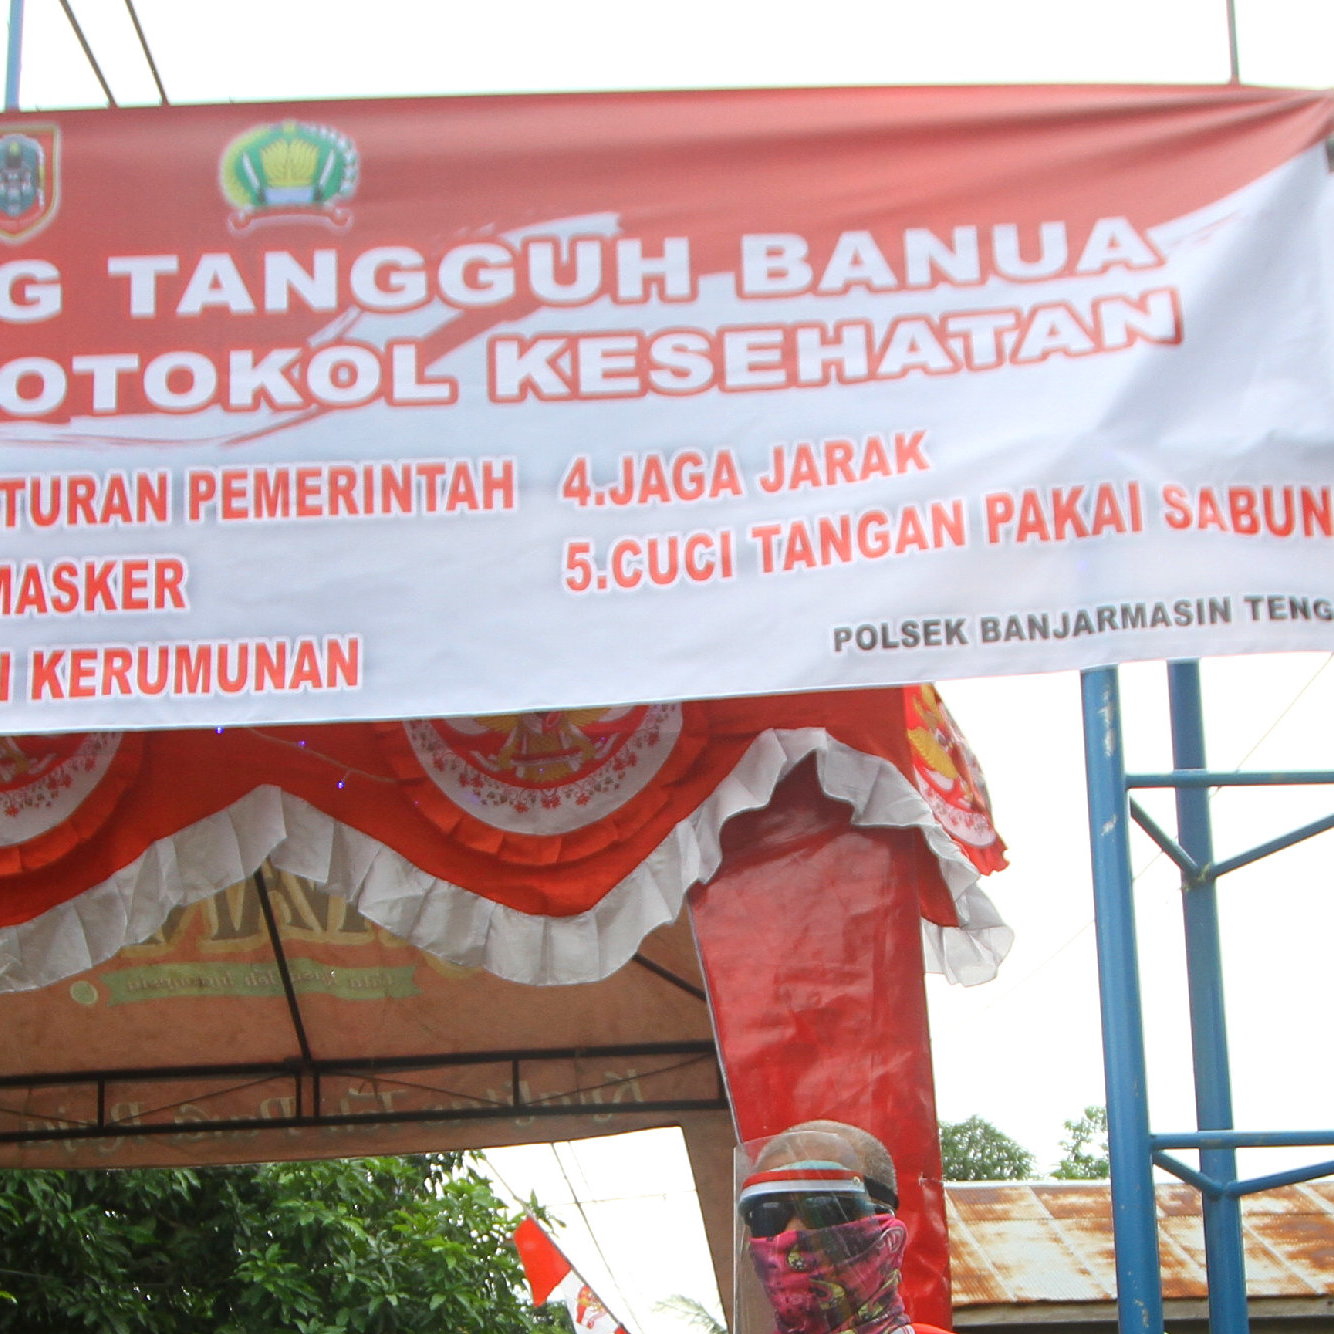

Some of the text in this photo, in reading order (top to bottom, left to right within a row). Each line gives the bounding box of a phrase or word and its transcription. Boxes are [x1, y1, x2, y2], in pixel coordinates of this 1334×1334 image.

[107, 234, 691, 318] TANGGUH
[742, 218, 1160, 298] BANUA
[493, 289, 1180, 397] KESEHATAN
[190, 460, 515, 521] PEMERINTAH
[564, 431, 929, 507] 4.JAGA JARAK
[565, 533, 732, 592] 5.CUCI
[753, 502, 967, 574] TANGAN
[987, 482, 1144, 545] PAKAI
[833, 617, 969, 653] POLSEK
[981, 600, 1232, 644] BANJARMASIN
[30, 639, 359, 702] KERUMUNAN
